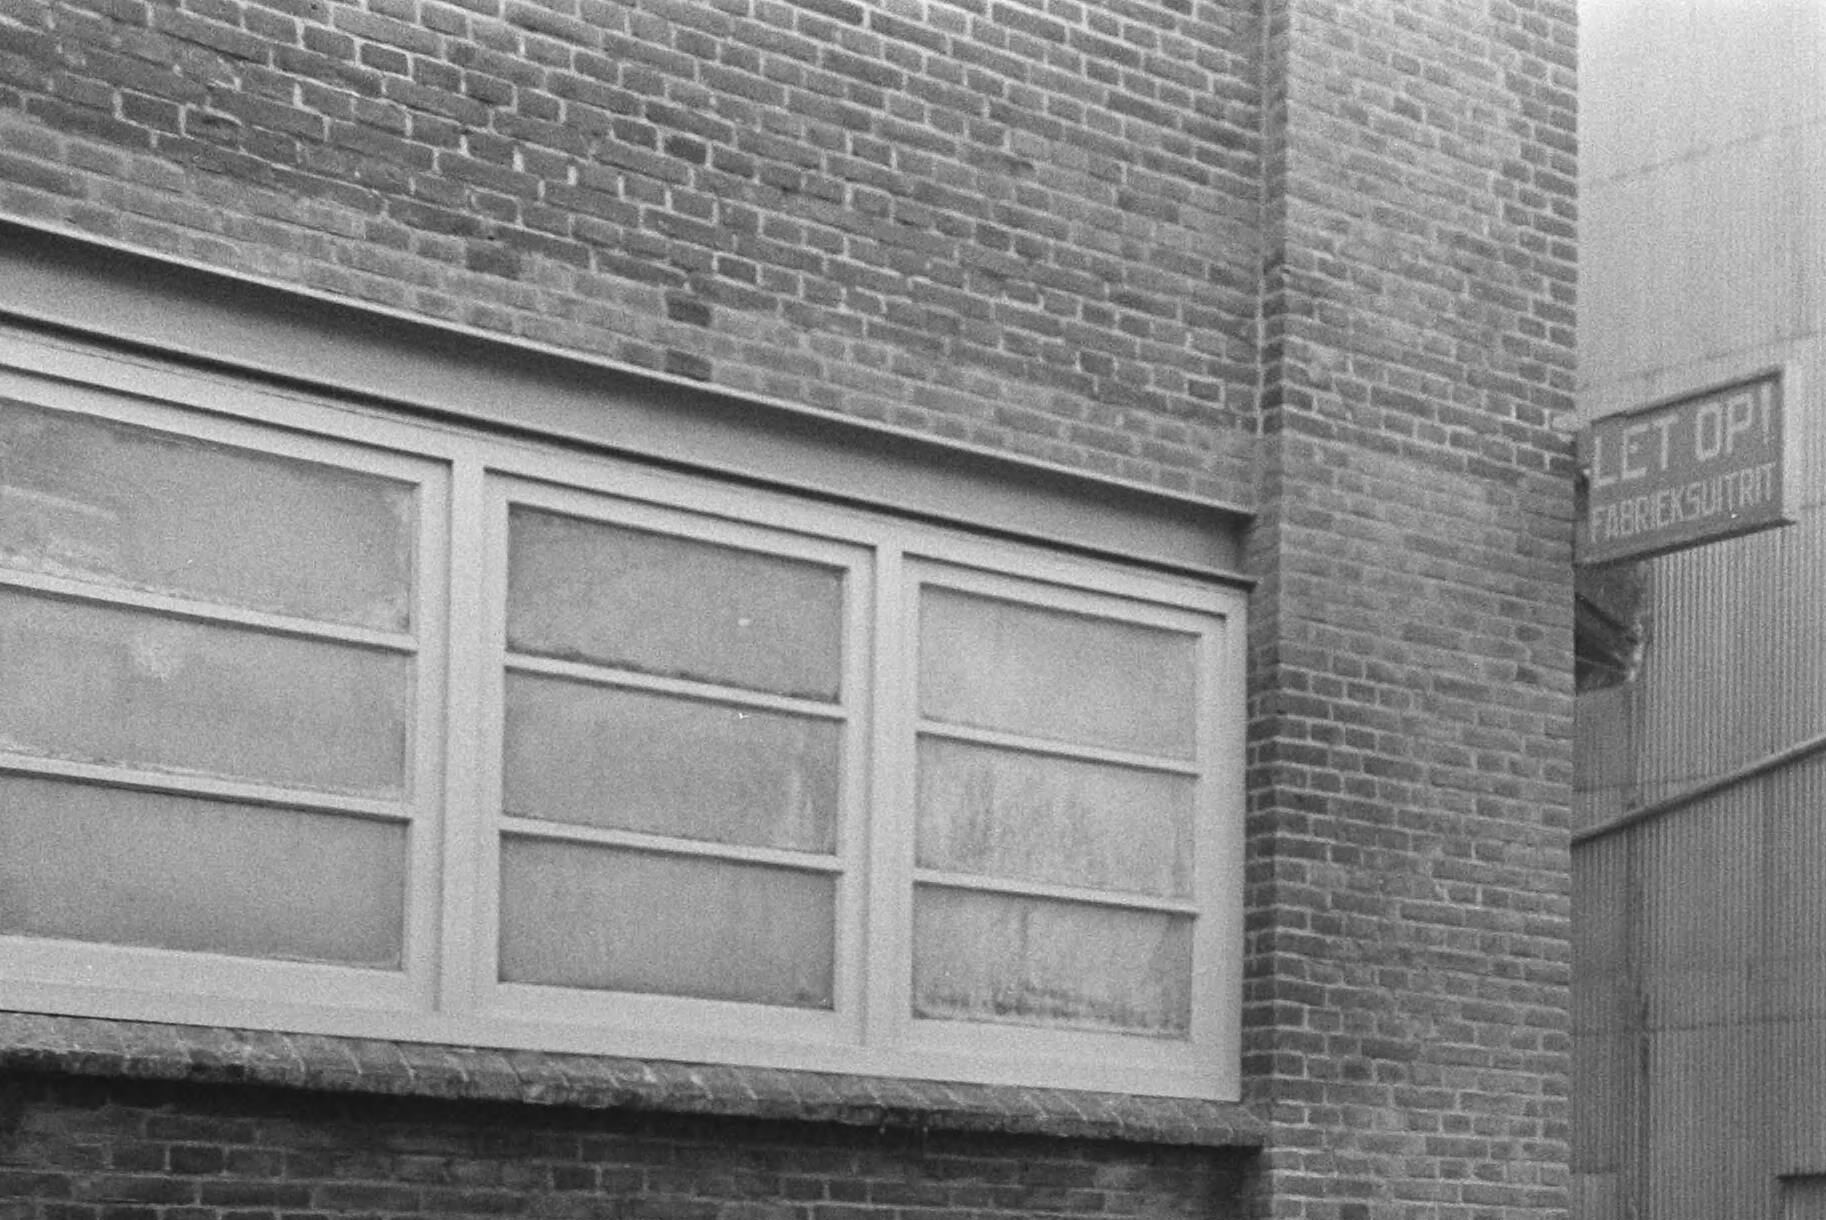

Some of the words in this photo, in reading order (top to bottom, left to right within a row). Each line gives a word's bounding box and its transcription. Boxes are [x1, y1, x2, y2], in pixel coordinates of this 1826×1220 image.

[1592, 412, 1679, 488] LET
[1695, 384, 1771, 461] OP!
[1590, 461, 1777, 544] FABRIEKSUITRIT
